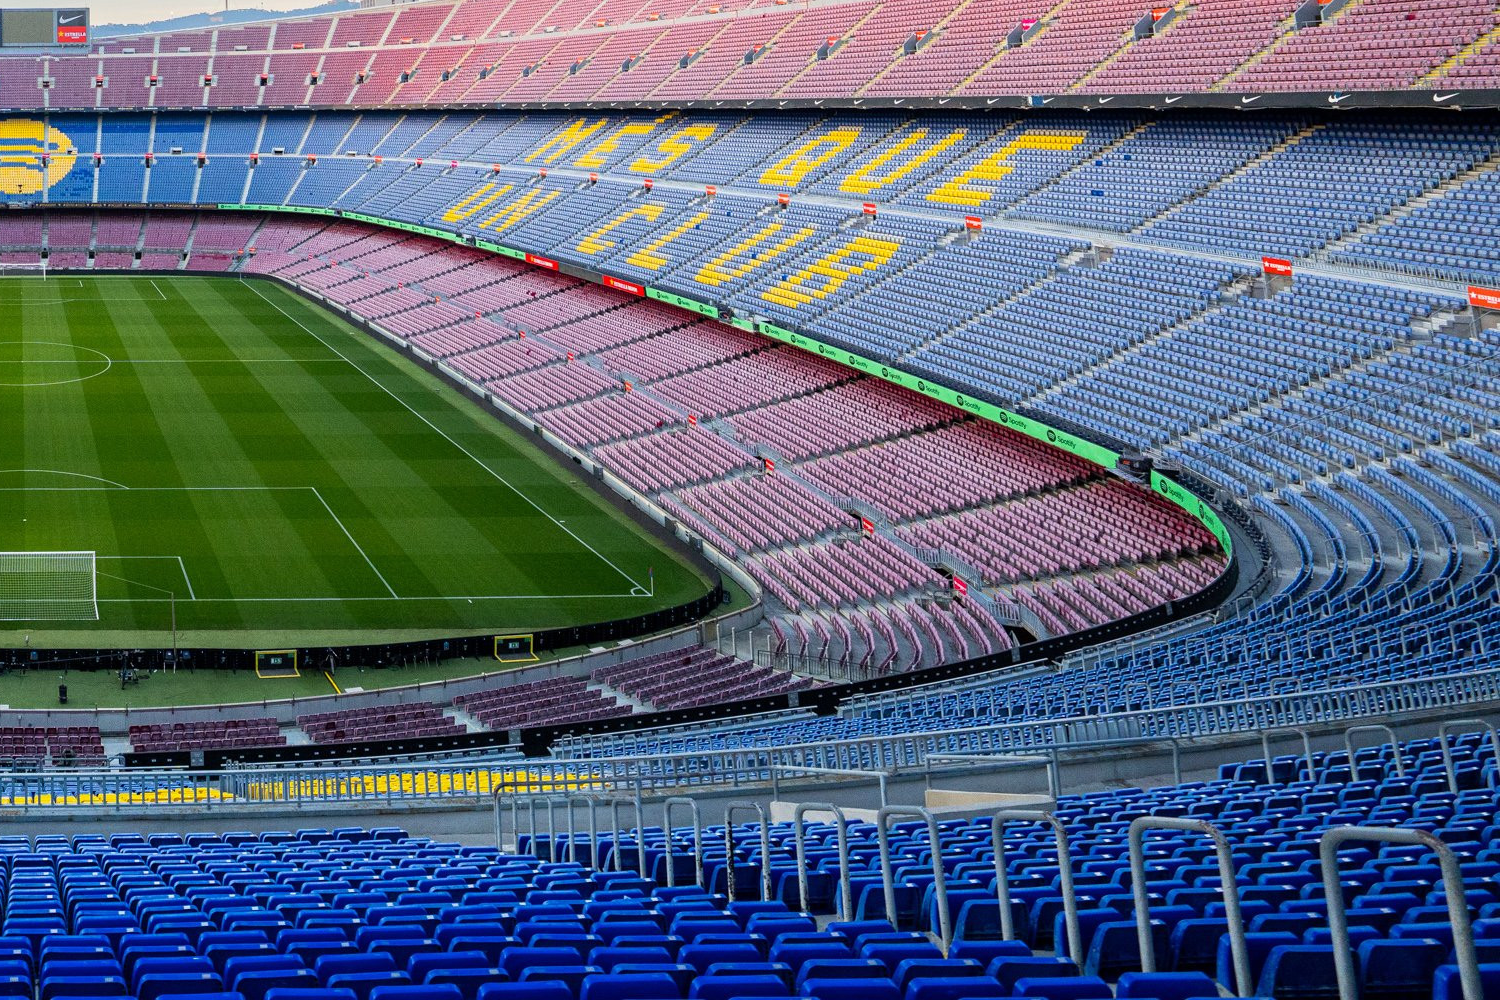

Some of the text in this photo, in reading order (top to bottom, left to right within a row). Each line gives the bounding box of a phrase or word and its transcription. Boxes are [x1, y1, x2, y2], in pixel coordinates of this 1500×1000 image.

[442, 181, 902, 309] UN CLUB
[796, 337, 807, 346] Spotify
[824, 347, 836, 357] Spotify
[854, 358, 868, 369] Spotify
[888, 370, 903, 382] Spotify
[925, 385, 940, 396] Spotify
[964, 399, 981, 412] Spotify
[1008, 416, 1027, 429] Spotify
[1057, 434, 1077, 449] Spotify
[1168, 485, 1184, 502] Spotify
